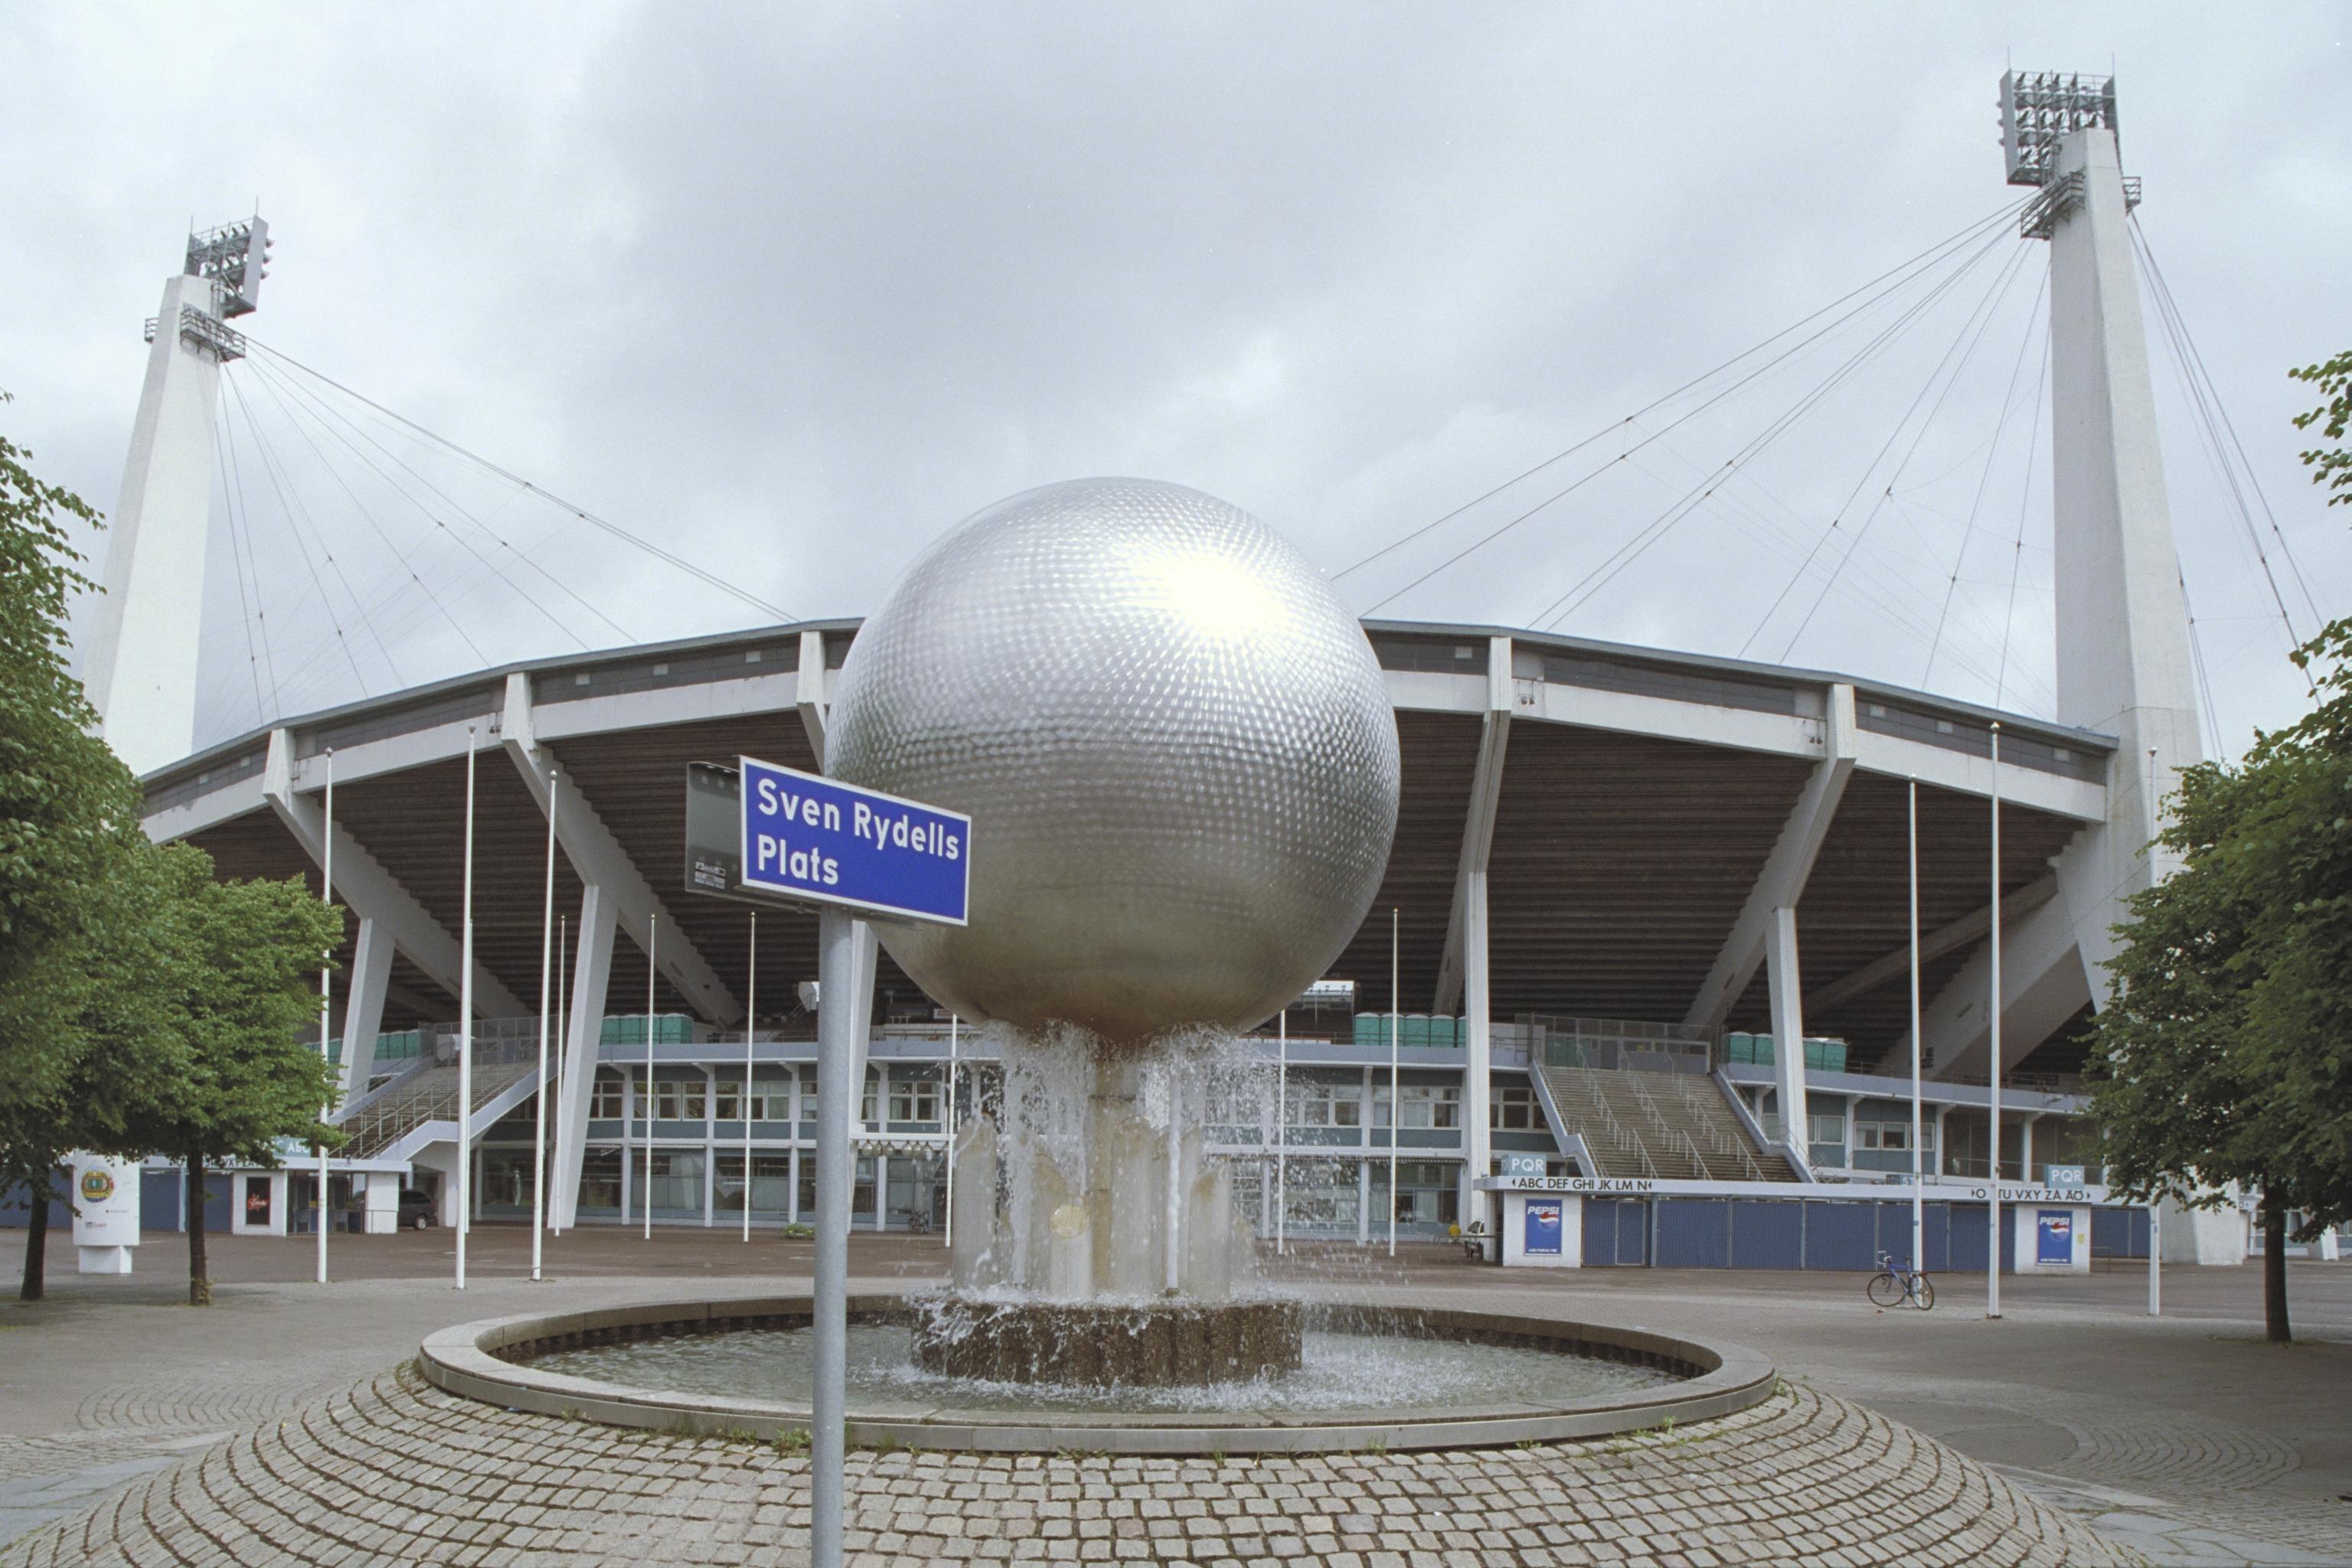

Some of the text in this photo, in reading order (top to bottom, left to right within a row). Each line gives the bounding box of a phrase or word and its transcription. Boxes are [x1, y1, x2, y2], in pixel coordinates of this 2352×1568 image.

[758, 779, 959, 861] Sven Rydells
[759, 835, 839, 885] Plats
[1511, 1158, 1544, 1171] PQR
[2052, 1170, 2082, 1182] PQR
[1518, 1178, 1647, 1191] ABC DEF GHI JK LM N
[1976, 1188, 1986, 1199] O
[2015, 1190, 2041, 1200] VXY
[1527, 1206, 1560, 1215] PEPSI
